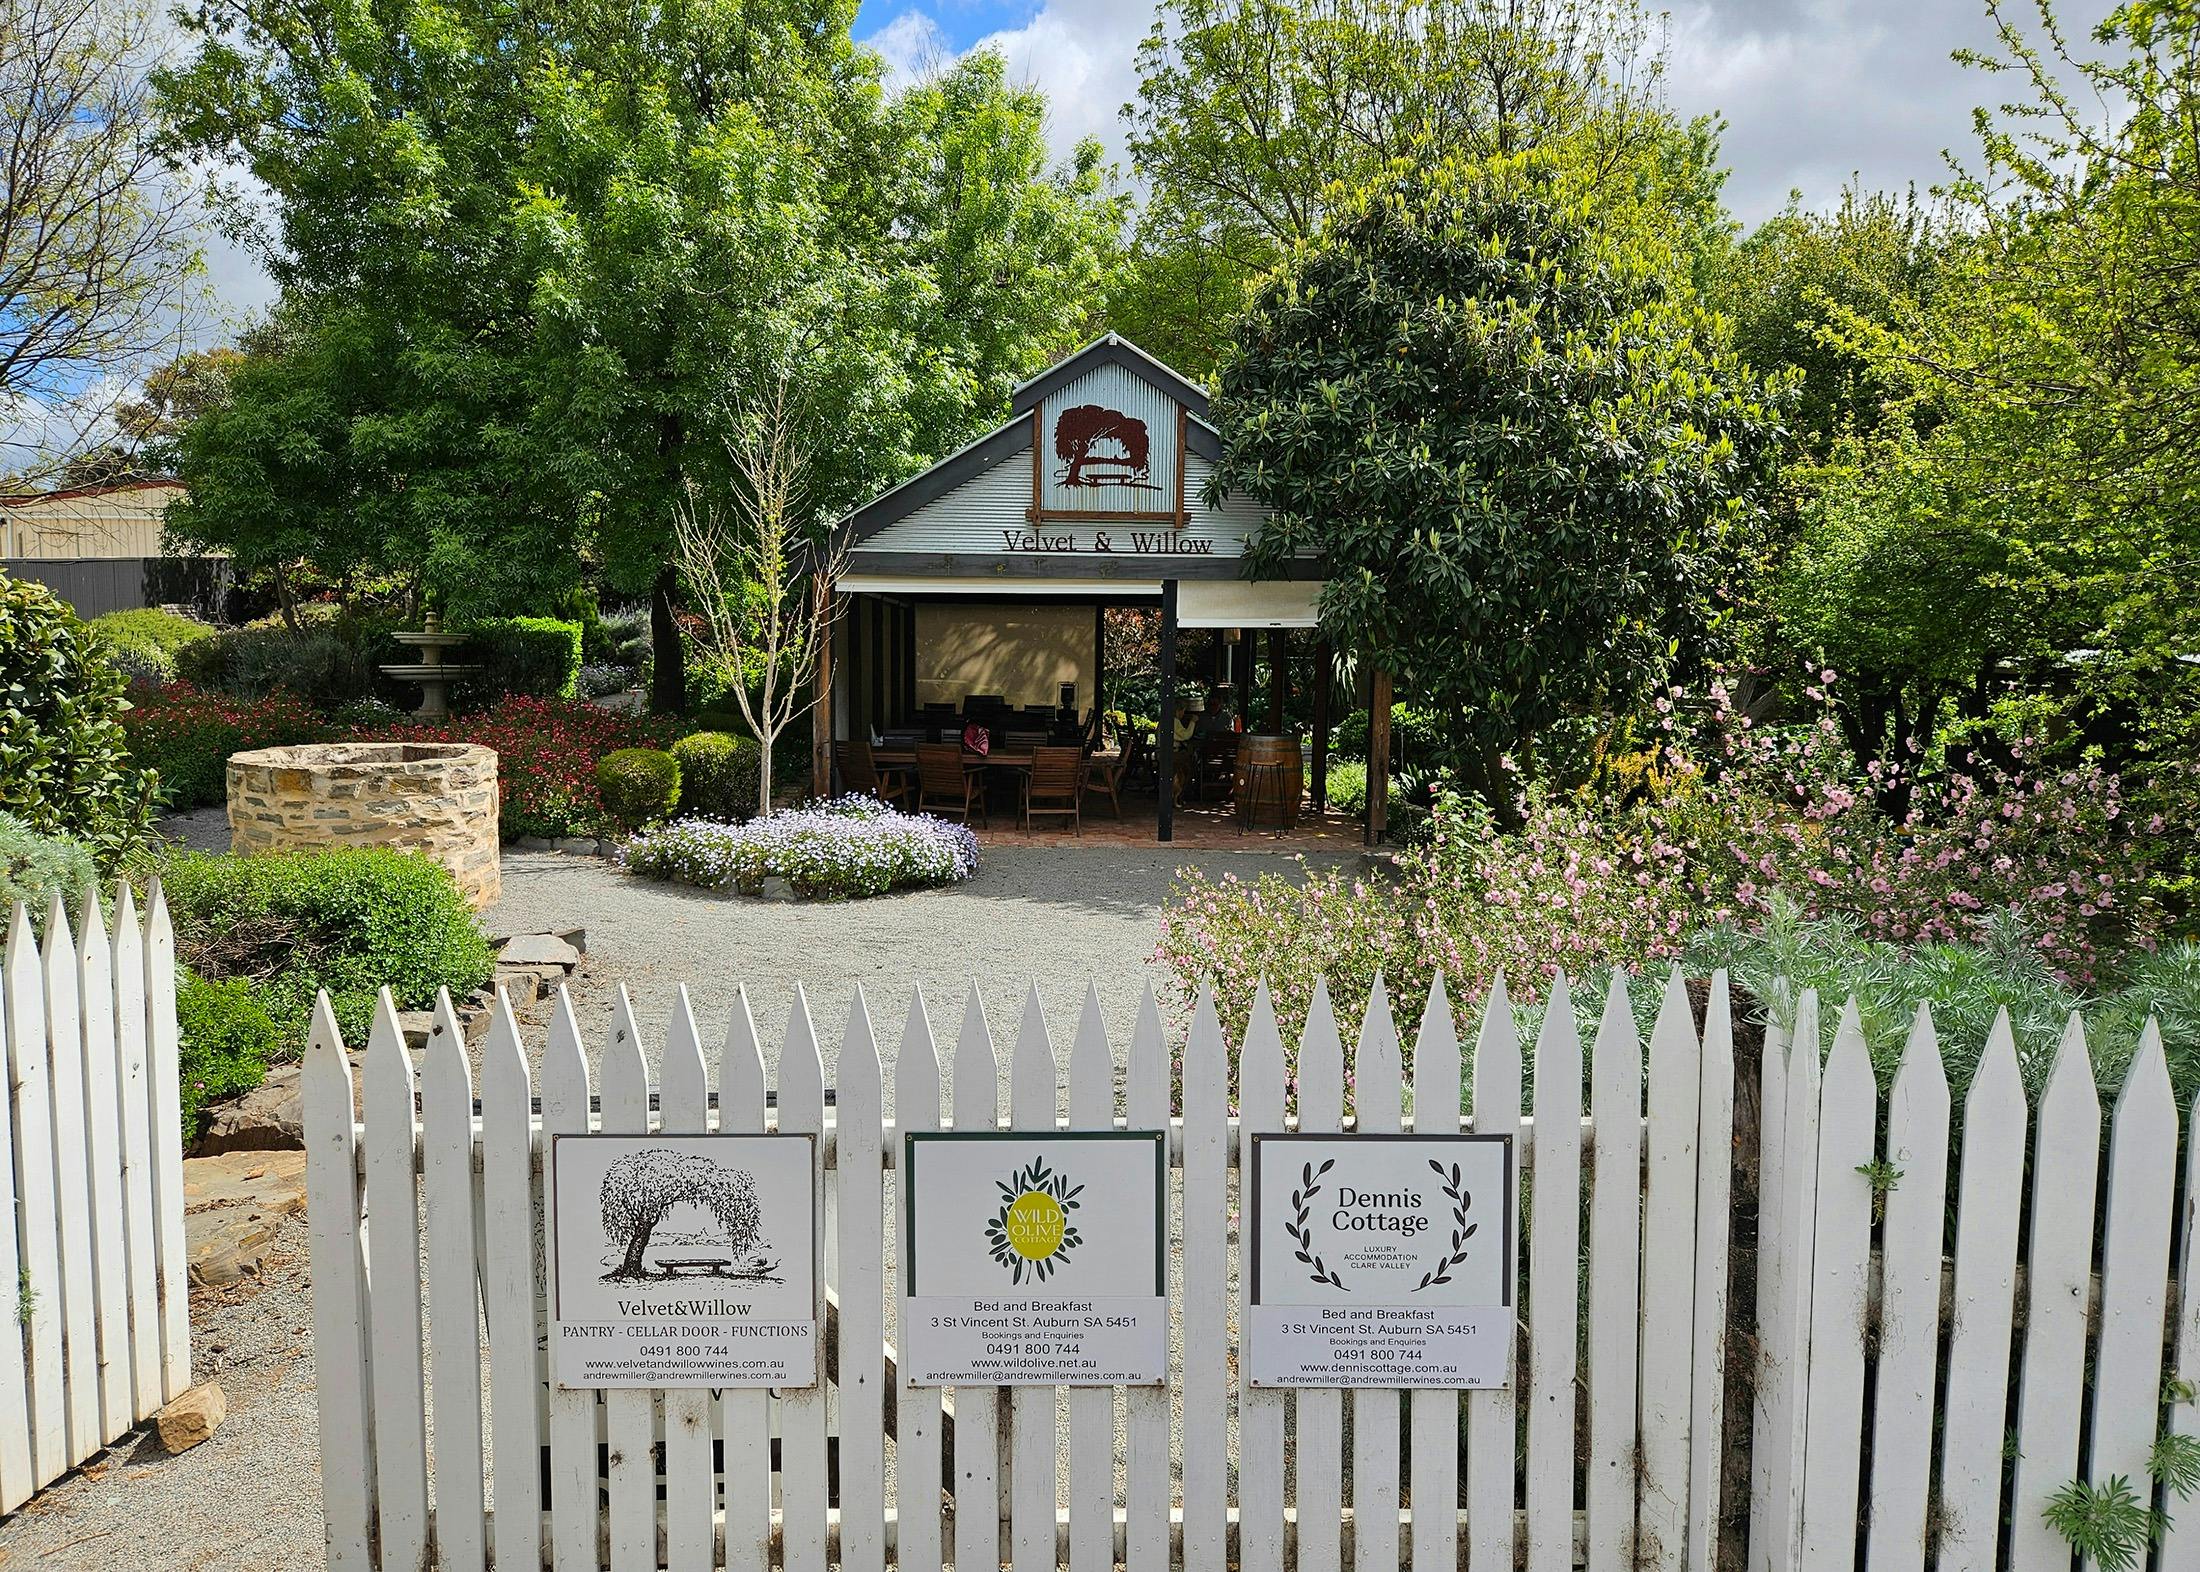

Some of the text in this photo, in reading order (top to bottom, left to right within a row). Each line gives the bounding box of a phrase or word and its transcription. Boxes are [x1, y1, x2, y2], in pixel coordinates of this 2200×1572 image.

[1003, 529, 1213, 554] Velvet & Willow
[1339, 1188, 1422, 1208] Dennis
[1014, 1209, 1059, 1223] WILD
[1332, 1210, 1428, 1237] Cottage
[1012, 1224, 1060, 1237] OLIVE
[618, 1299, 752, 1316] Velvet&Willow
[974, 1302, 1092, 1312] Bed and Breakfast
[1322, 1309, 1434, 1319] Bed and Breakfast
[931, 1317, 1137, 1327] 3 St Vincent St. Auburn SA 5451
[563, 1327, 615, 1337] PANTRY
[627, 1327, 677, 1337] CELLAR
[682, 1327, 719, 1337] DOOR
[732, 1326, 808, 1337] FUNCTIONS
[1282, 1324, 1477, 1335] 3 St Vincent St. Auburn SA 5451
[982, 1332, 1022, 1340] Bookings
[1044, 1332, 1084, 1340] Enquiries
[1330, 1338, 1426, 1346] Bookings and Enquiries
[640, 1346, 728, 1356] 0491 800 744
[987, 1344, 1080, 1354] 0491 800 744
[1334, 1350, 1422, 1360] 0491 800 744
[585, 1359, 784, 1369] www.velvetandwillowwines.com.au
[971, 1358, 1096, 1368] www.wildolive.net.au
[1300, 1364, 1457, 1374] www.denniscottage.com.au
[583, 1371, 786, 1381] andrewmiller@andrewmillerwines.com.au
[927, 1371, 1141, 1381] andrewmiller@andrewmillerwines.com.au
[1277, 1375, 1480, 1385] andrewmiller@andrewmillerwines.com.au
